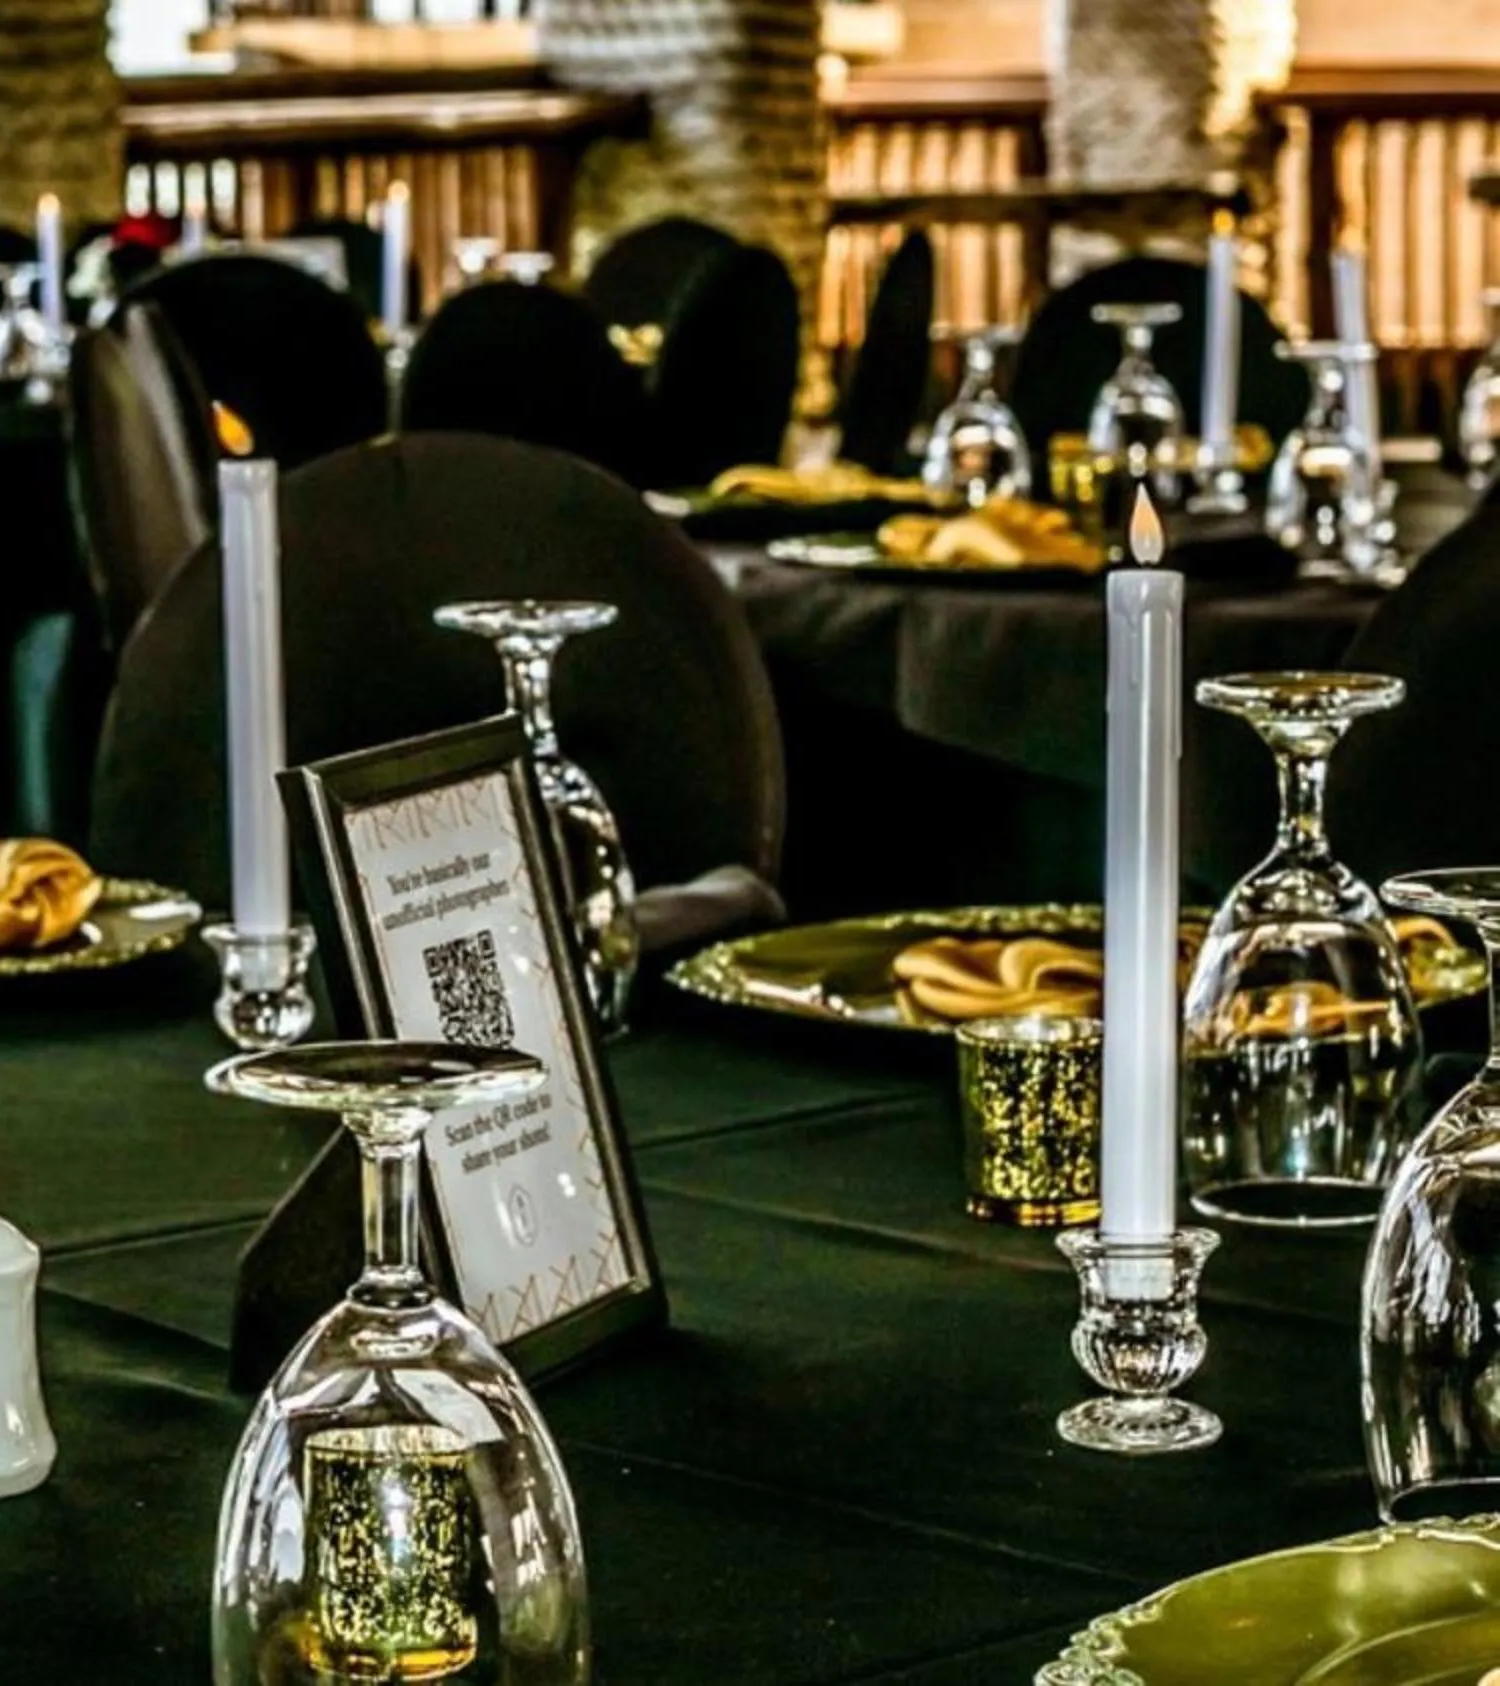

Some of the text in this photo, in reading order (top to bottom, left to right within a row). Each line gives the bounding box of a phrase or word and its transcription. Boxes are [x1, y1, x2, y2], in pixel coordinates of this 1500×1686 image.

[444, 1092, 553, 1147] Scan the QR code to
[461, 1150, 493, 1174] share
[493, 1140, 518, 1166] your
